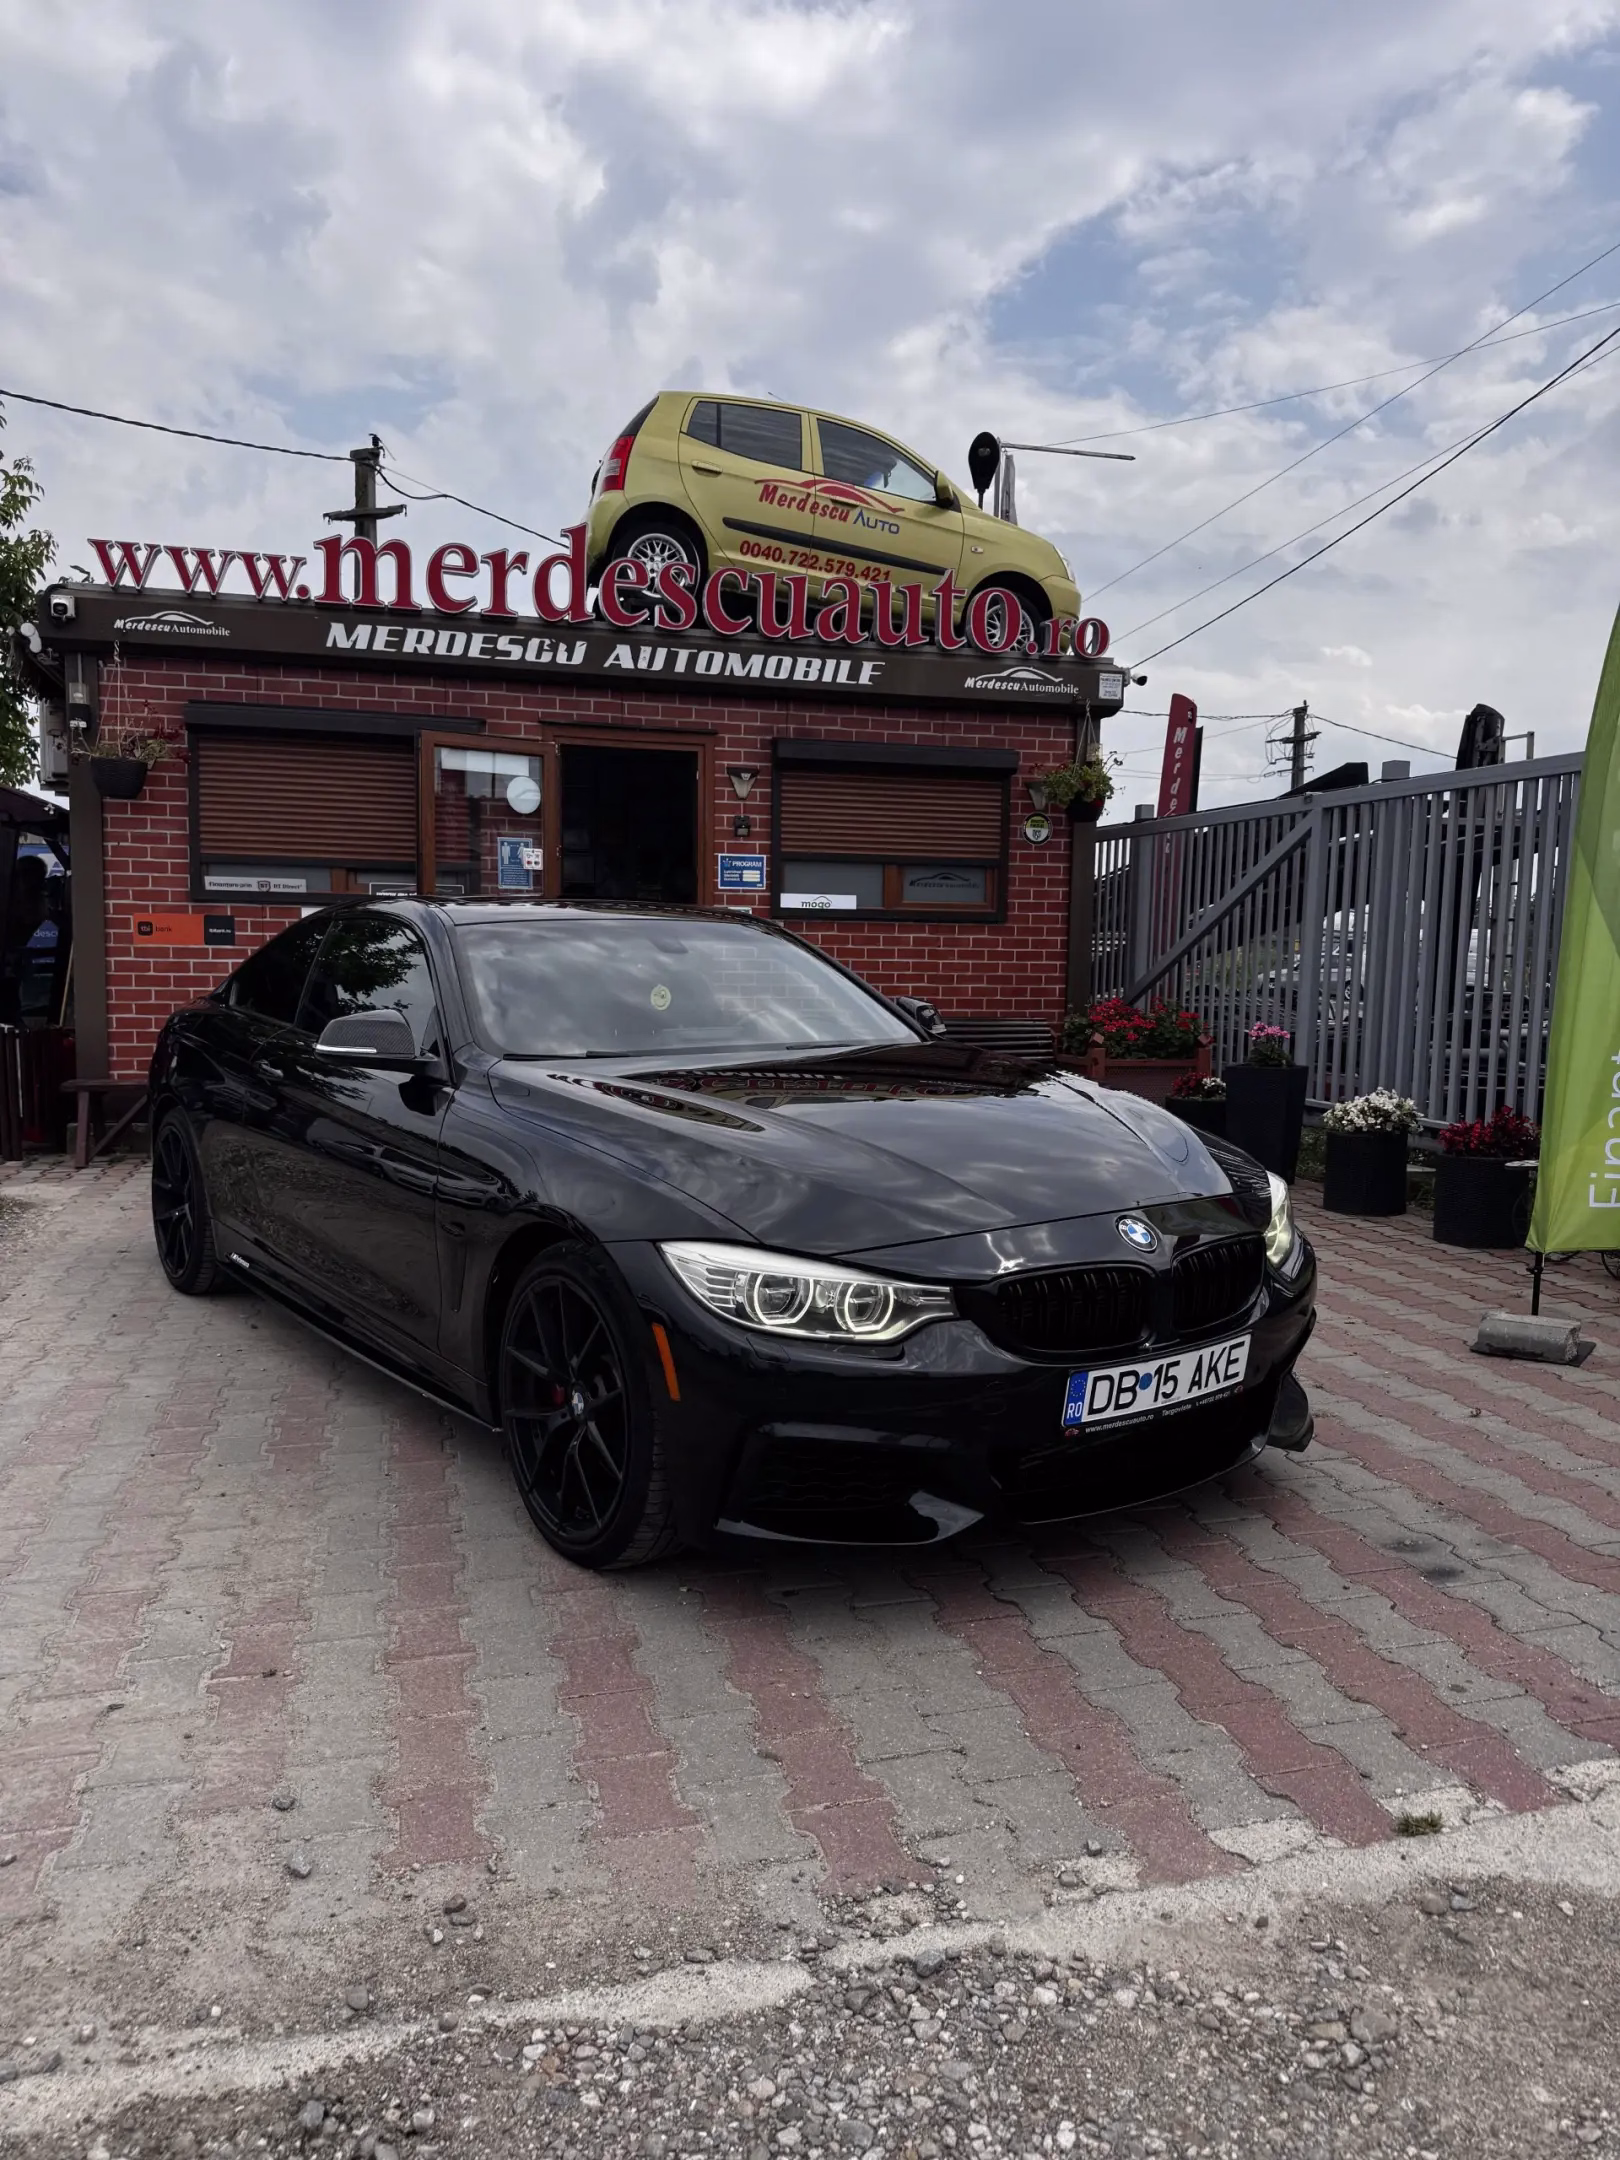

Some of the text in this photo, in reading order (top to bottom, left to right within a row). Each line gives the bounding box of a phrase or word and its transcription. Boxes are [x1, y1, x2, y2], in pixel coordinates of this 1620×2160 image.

[758, 484, 900, 535] Merdescu AUTO
[88, 522, 1110, 659] www.merdescuauto.ro
[325, 622, 886, 685] MERDESCU AUTOMOBILE
[1087, 1340, 1246, 1417] DB 15 AKE
[1066, 1401, 1084, 1420] RO
[1085, 1413, 1155, 1434] www.merdescuauto.ro
